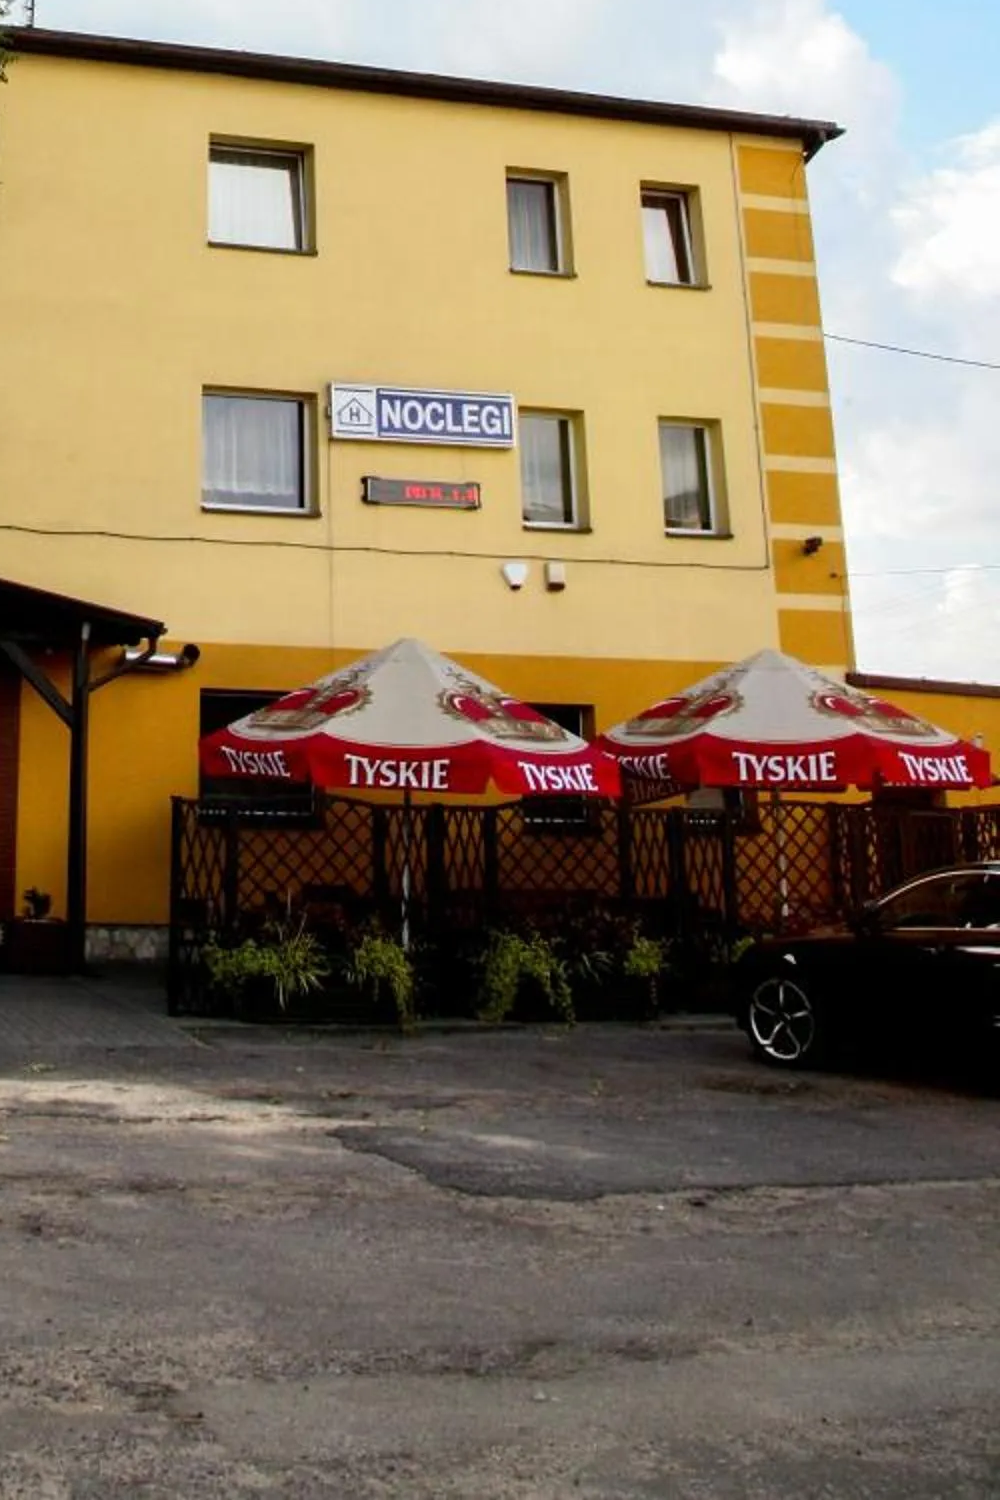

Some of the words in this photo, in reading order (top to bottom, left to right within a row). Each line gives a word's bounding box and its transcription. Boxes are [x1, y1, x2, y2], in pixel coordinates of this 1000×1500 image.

[380, 399, 511, 435] NOCLEGI
[220, 745, 291, 777] TYSKIE
[344, 753, 450, 790] TYSKIE
[518, 761, 599, 792] TYSKIE
[732, 751, 837, 782] TYSKIE
[898, 751, 974, 783] TYSKIE
